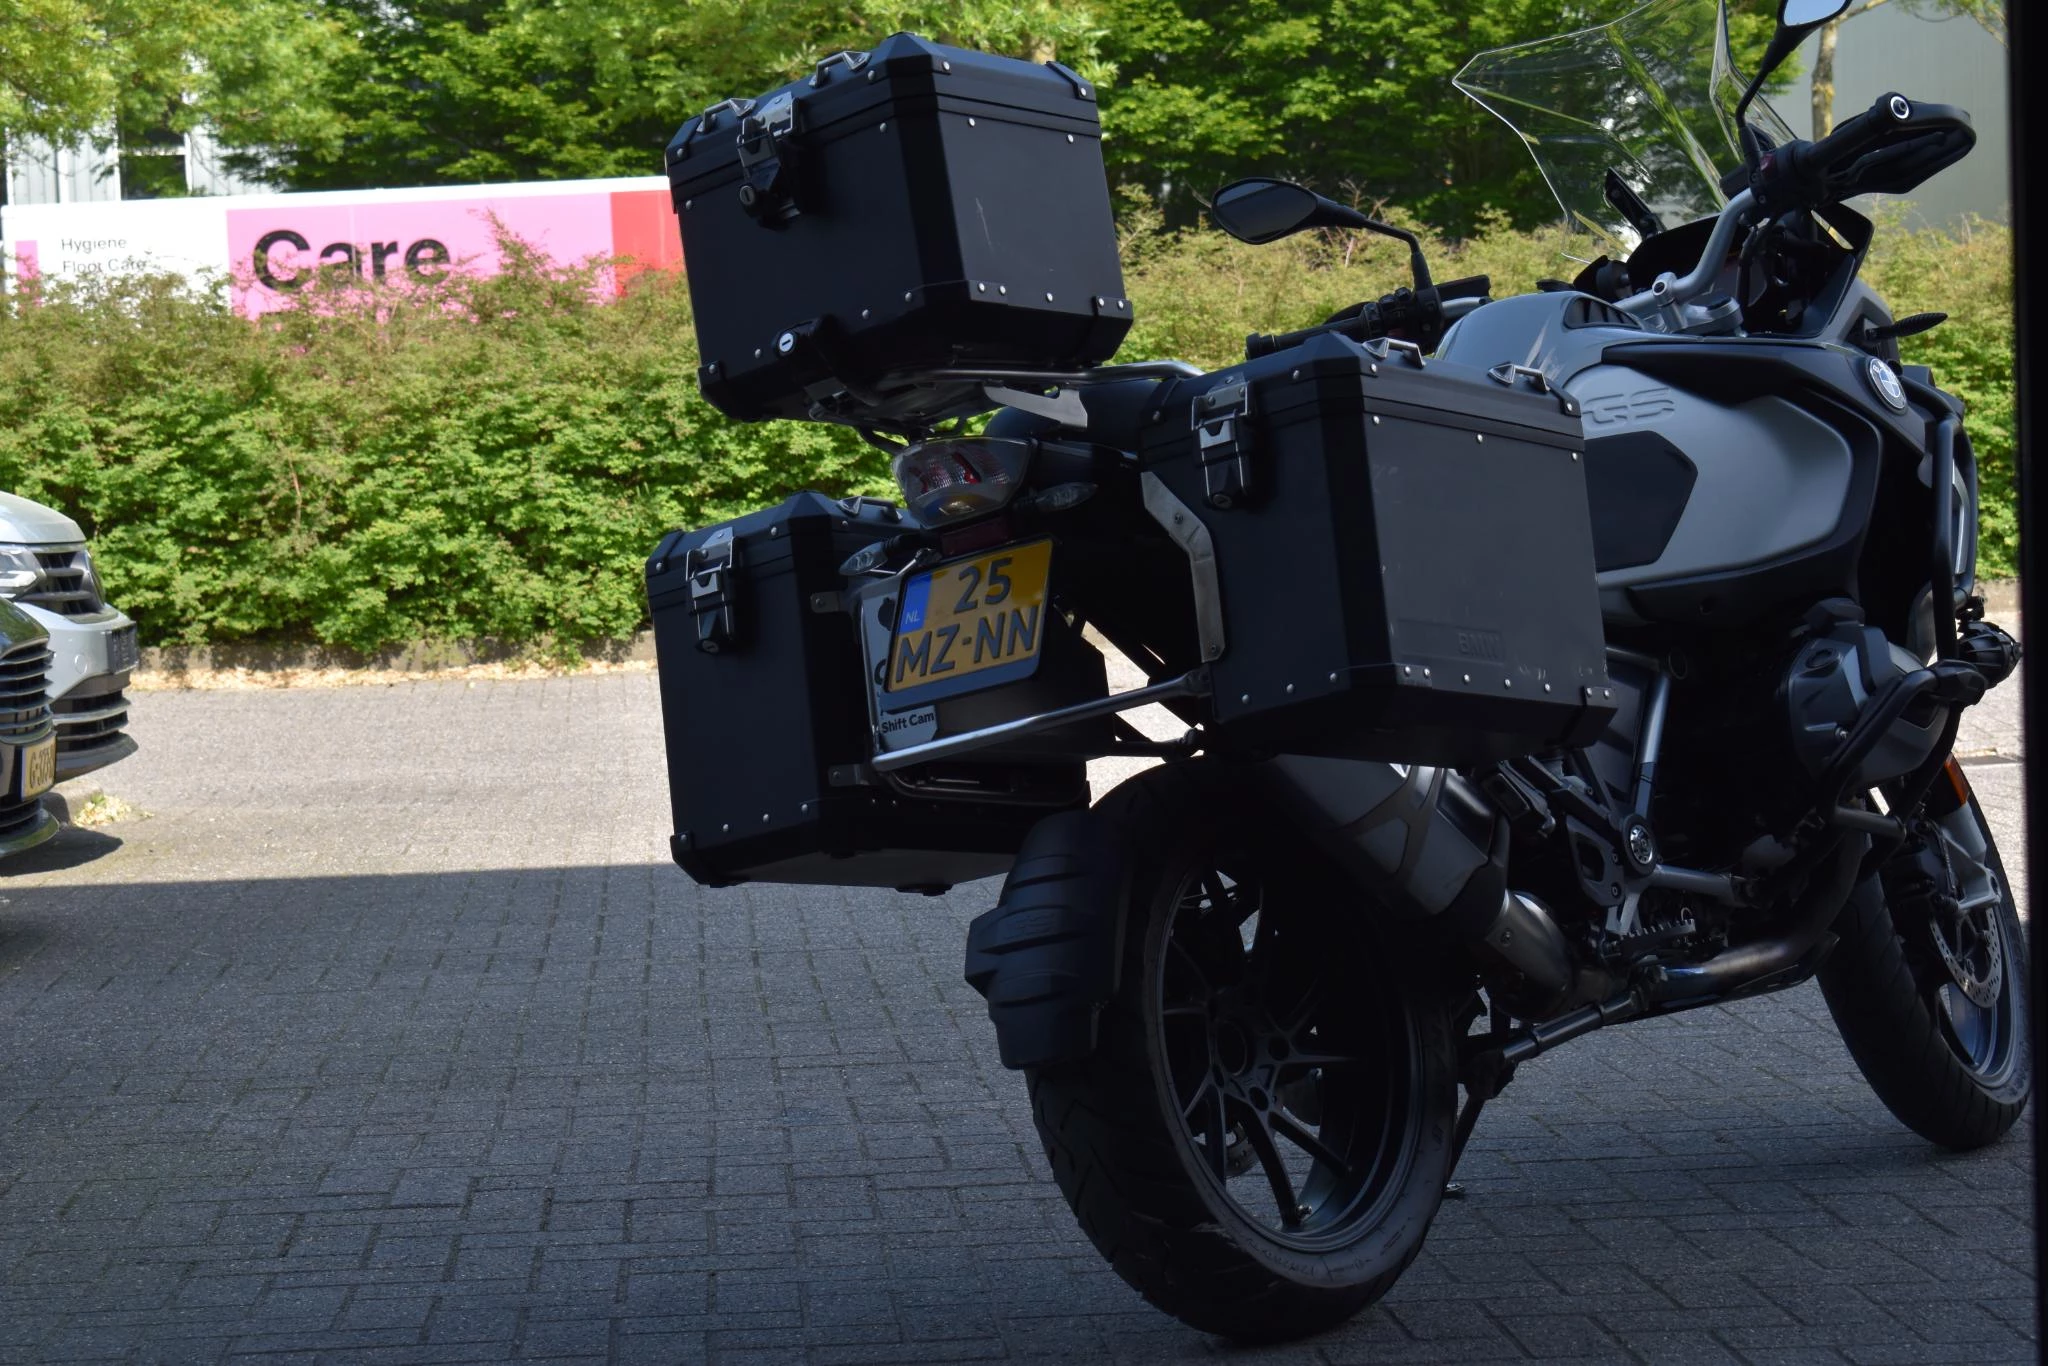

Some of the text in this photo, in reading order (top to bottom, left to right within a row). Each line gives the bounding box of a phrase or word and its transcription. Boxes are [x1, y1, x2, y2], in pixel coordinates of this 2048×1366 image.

[61, 237, 127, 254] Hygiene
[63, 258, 148, 274] Floor Care
[253, 229, 450, 290] Care
[954, 557, 1013, 614] 25
[905, 609, 921, 625] NL
[895, 605, 1040, 684] MZ-NN
[881, 711, 935, 735] Shift Cam
